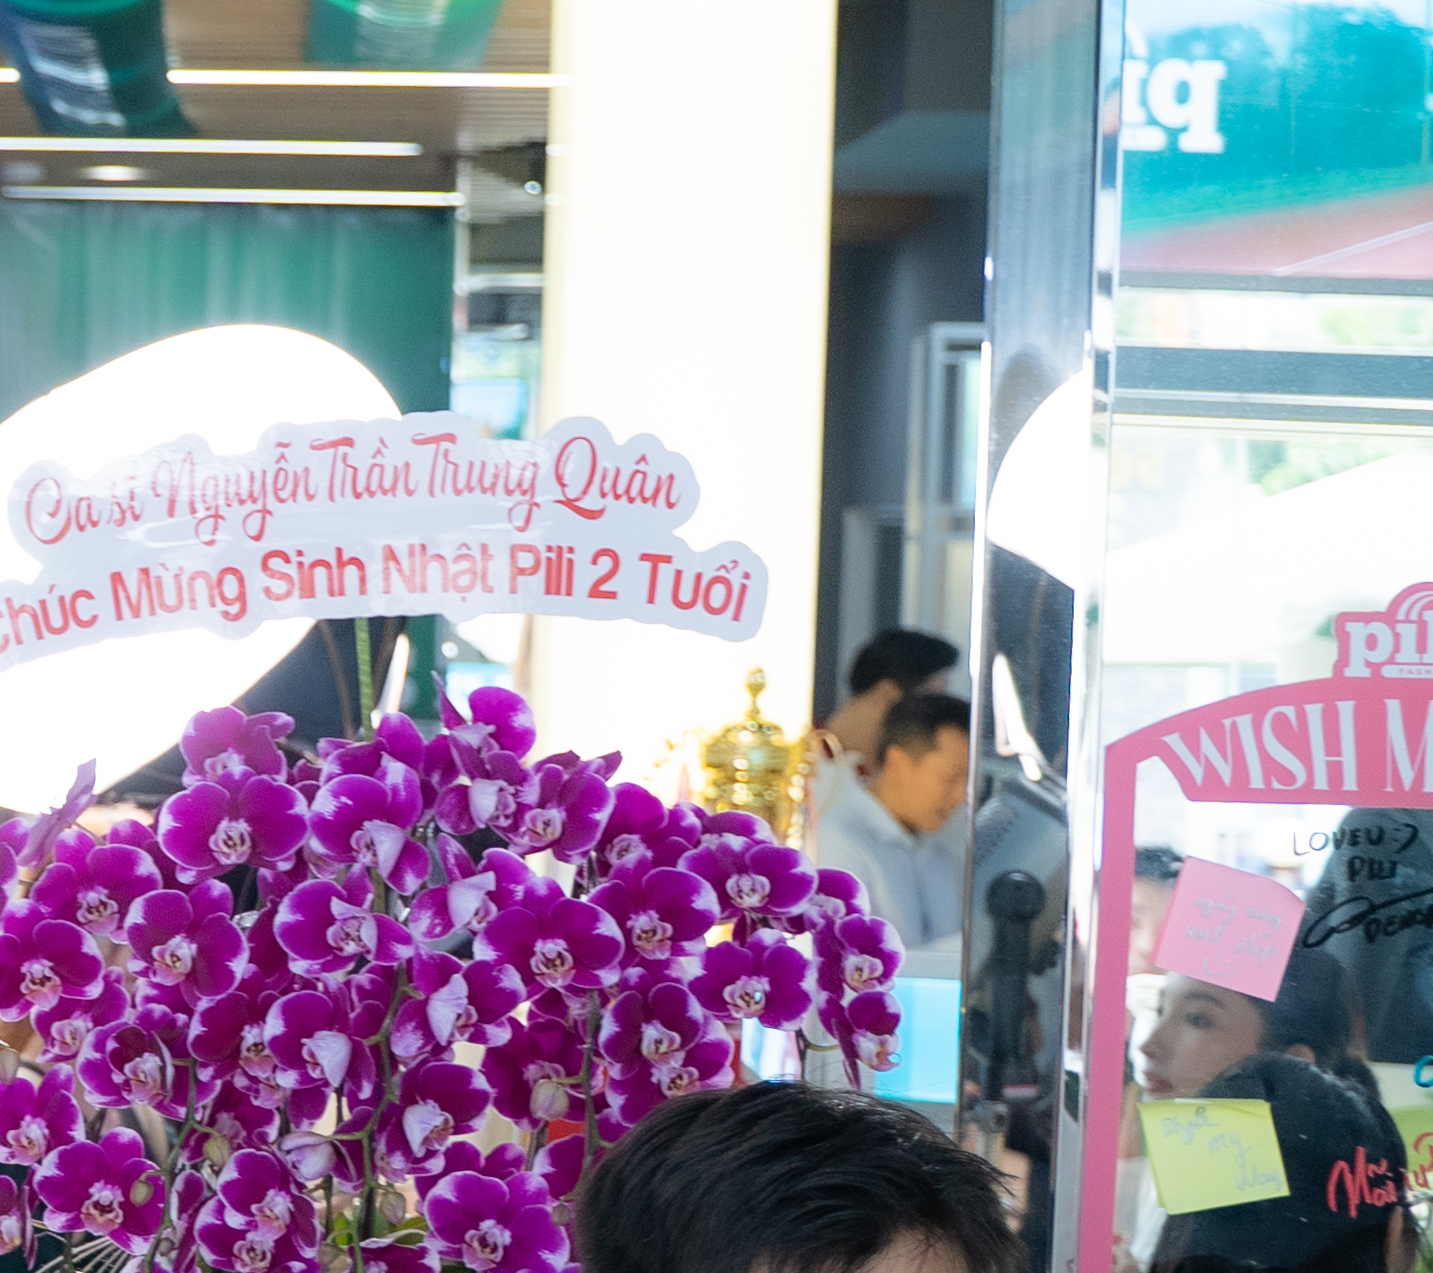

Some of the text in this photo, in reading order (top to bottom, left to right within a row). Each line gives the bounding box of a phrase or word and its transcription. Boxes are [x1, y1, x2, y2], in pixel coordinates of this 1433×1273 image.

[22, 477, 100, 545] Ca
[152, 441, 321, 547] Nguyễn
[310, 435, 419, 505] Trần
[410, 432, 541, 533] Trung
[554, 435, 683, 521] Quân
[110, 562, 249, 622] Mừng
[260, 546, 368, 602] Sinh
[382, 542, 494, 603] Nhật
[508, 543, 575, 597] Pili
[587, 547, 622, 601] 2
[639, 552, 752, 623] Tuổi
[1160, 699, 1358, 792] WISH
